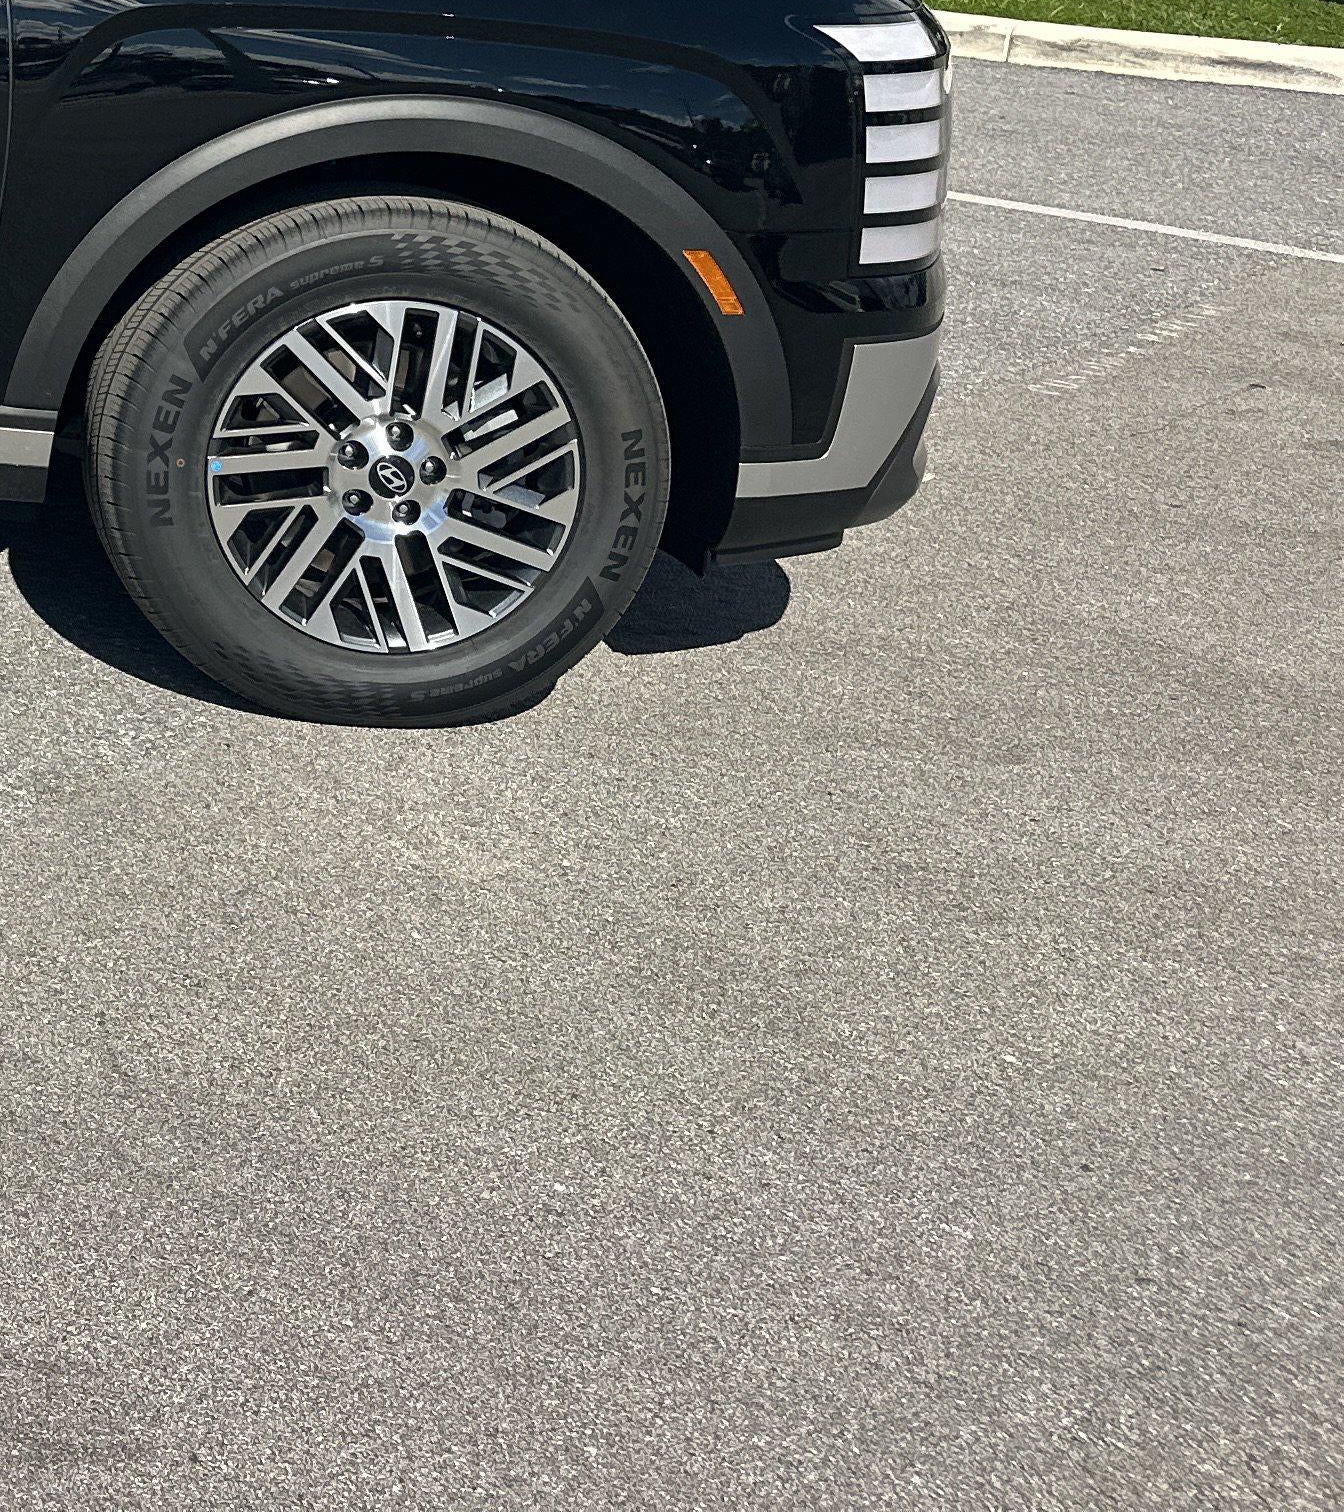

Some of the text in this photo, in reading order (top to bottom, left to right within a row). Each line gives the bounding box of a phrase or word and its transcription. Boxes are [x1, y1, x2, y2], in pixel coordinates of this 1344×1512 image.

[199, 286, 286, 361] N'FERA
[367, 255, 385, 268] S
[145, 374, 193, 527] NEXEN
[599, 428, 647, 583] NEXEN
